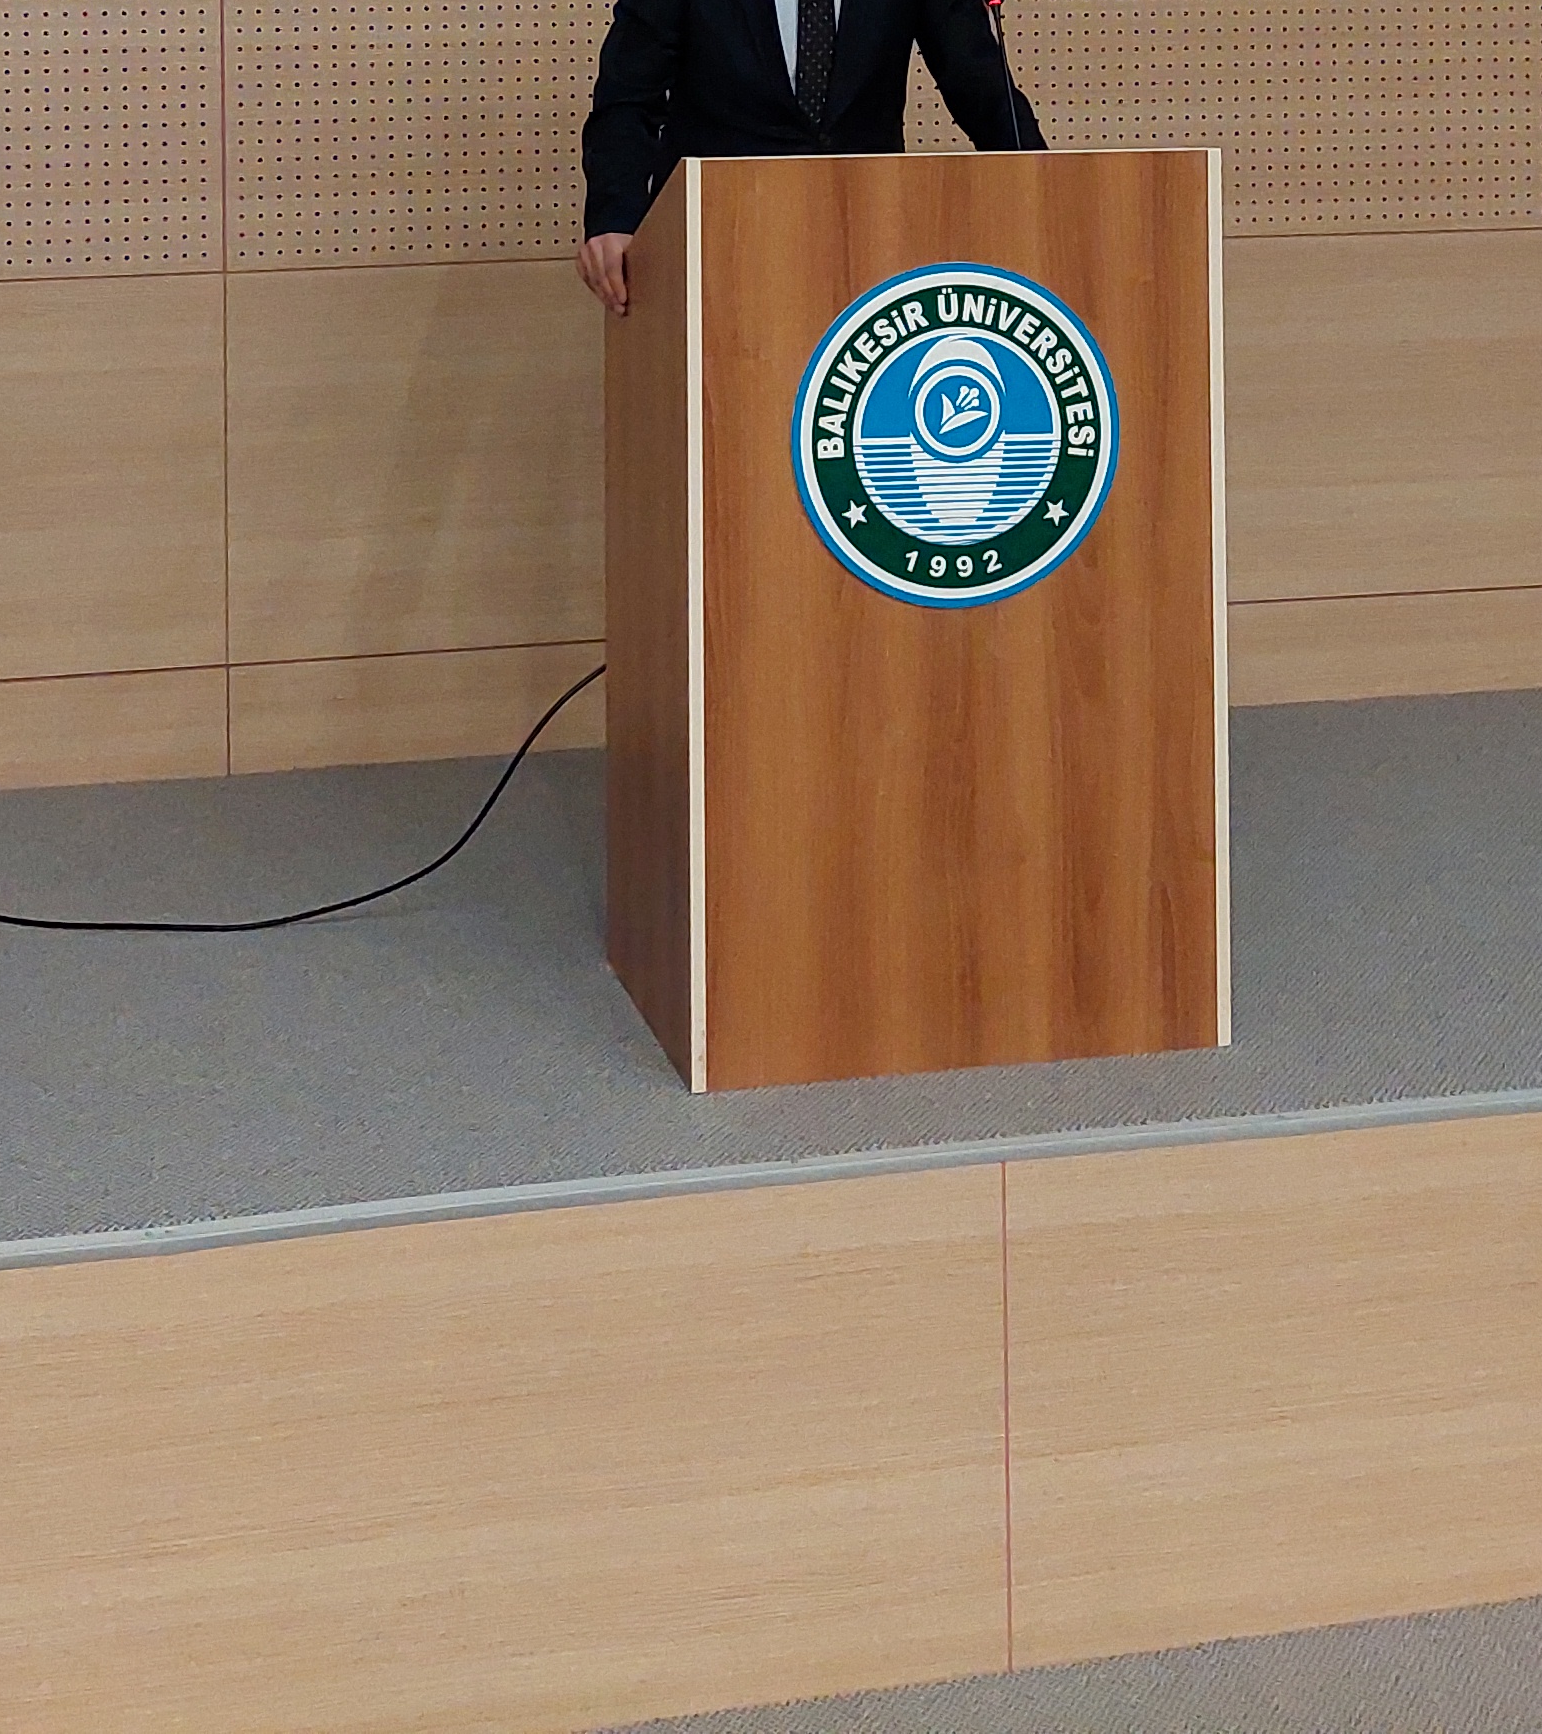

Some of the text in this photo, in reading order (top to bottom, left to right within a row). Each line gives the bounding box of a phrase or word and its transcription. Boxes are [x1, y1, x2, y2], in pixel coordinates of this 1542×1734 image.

[817, 287, 1097, 460] BALIKESİR ÜNİVERSİTESİ
[905, 549, 1003, 578] 1992
